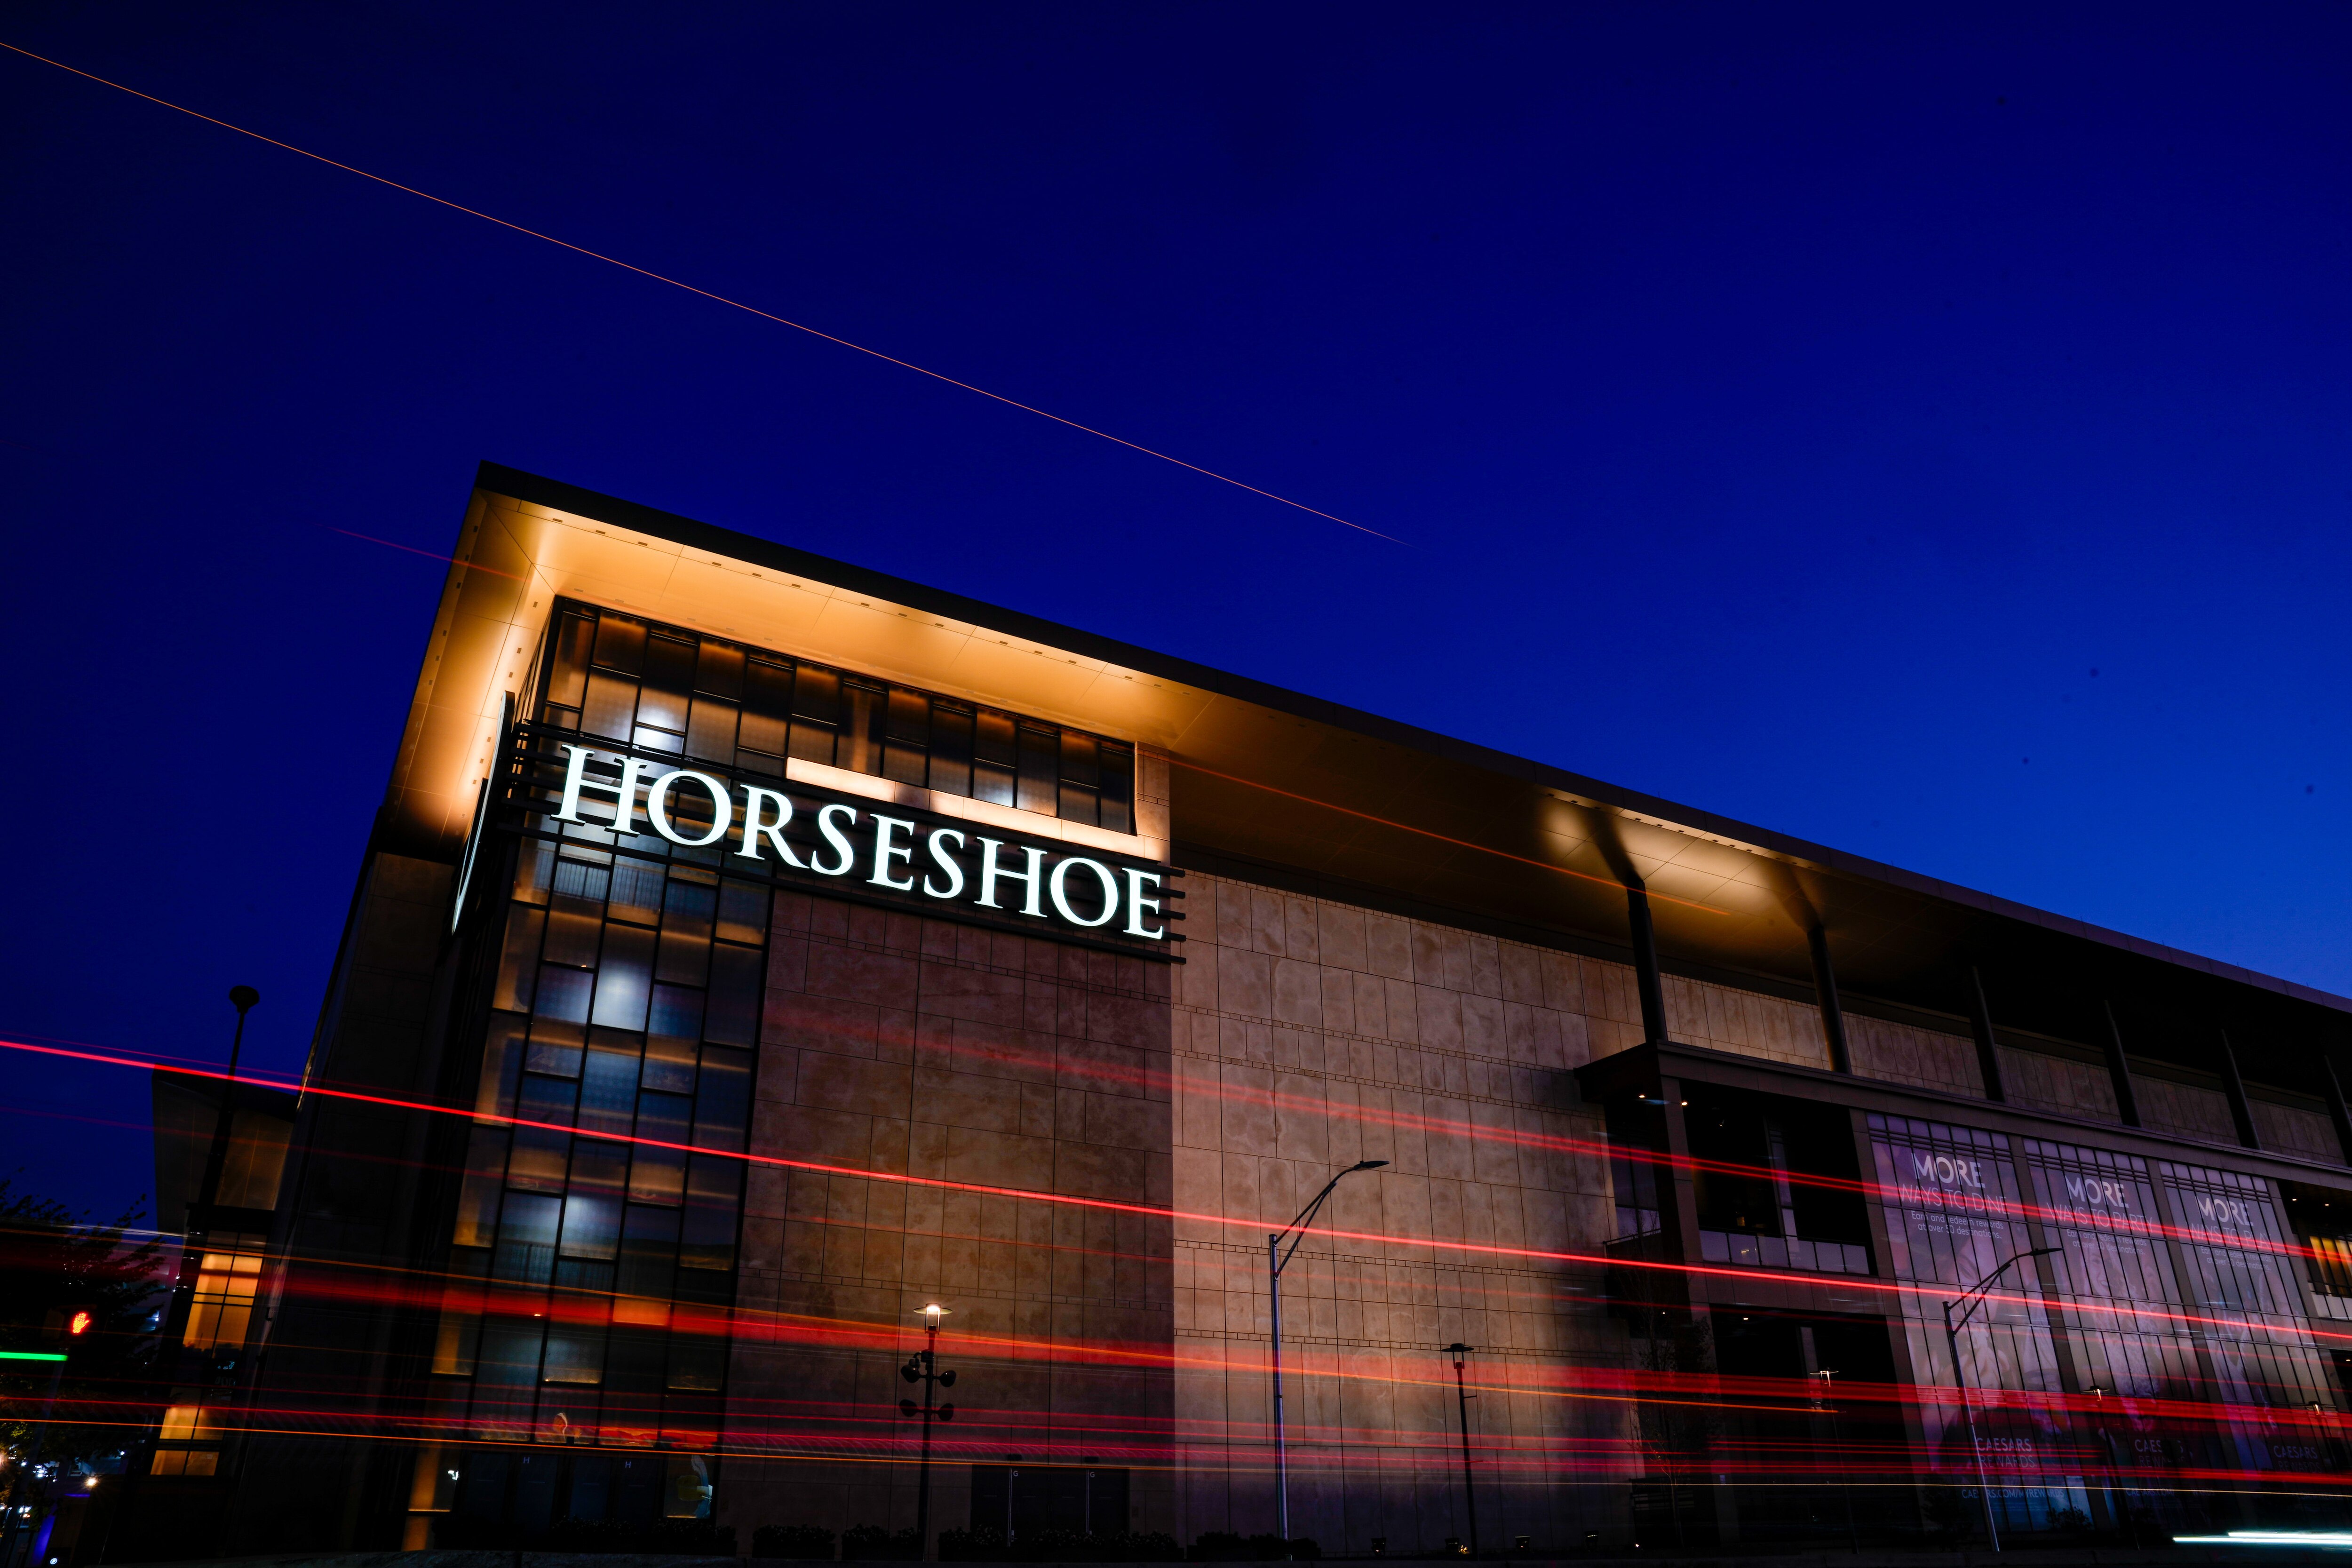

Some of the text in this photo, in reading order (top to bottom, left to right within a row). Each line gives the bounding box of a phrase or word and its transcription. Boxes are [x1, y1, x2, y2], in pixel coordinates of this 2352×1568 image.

[550, 744, 1165, 939] HORSESHOE
[1911, 1153, 1985, 1188] MORE
[1895, 1182, 2010, 1214] WAYS TO DINE
[2065, 1176, 2129, 1208] MORE
[2046, 1202, 2153, 1233] WAYS TO PARTY
[2195, 1196, 2254, 1226] MORE
[1911, 1210, 1928, 1220] Earn
[1948, 1216, 1974, 1226] redeem
[1976, 1220, 2003, 1229] rewards
[1946, 1225, 1954, 1234] 50
[1957, 1226, 2002, 1239] desinations.
[2066, 1229, 2082, 1238] Earn
[2098, 1234, 2121, 1242] edeem
[2186, 1223, 2271, 1249] WAYS TO PLAY
[2106, 1243, 2145, 1255] desinations.
[2201, 1246, 2212, 1255] Ear
[2229, 1250, 2249, 1259] edee
[2236, 1259, 2271, 1271] desinations.
[1976, 1437, 2032, 1452] CAESARS
[2135, 1439, 2184, 1453] CAESS
[2273, 1445, 2318, 1459] CAESARS
[1980, 1455, 2035, 1468] REWARDS
[1962, 1488, 2064, 1498] CAERS.COM/MYREWARDS
